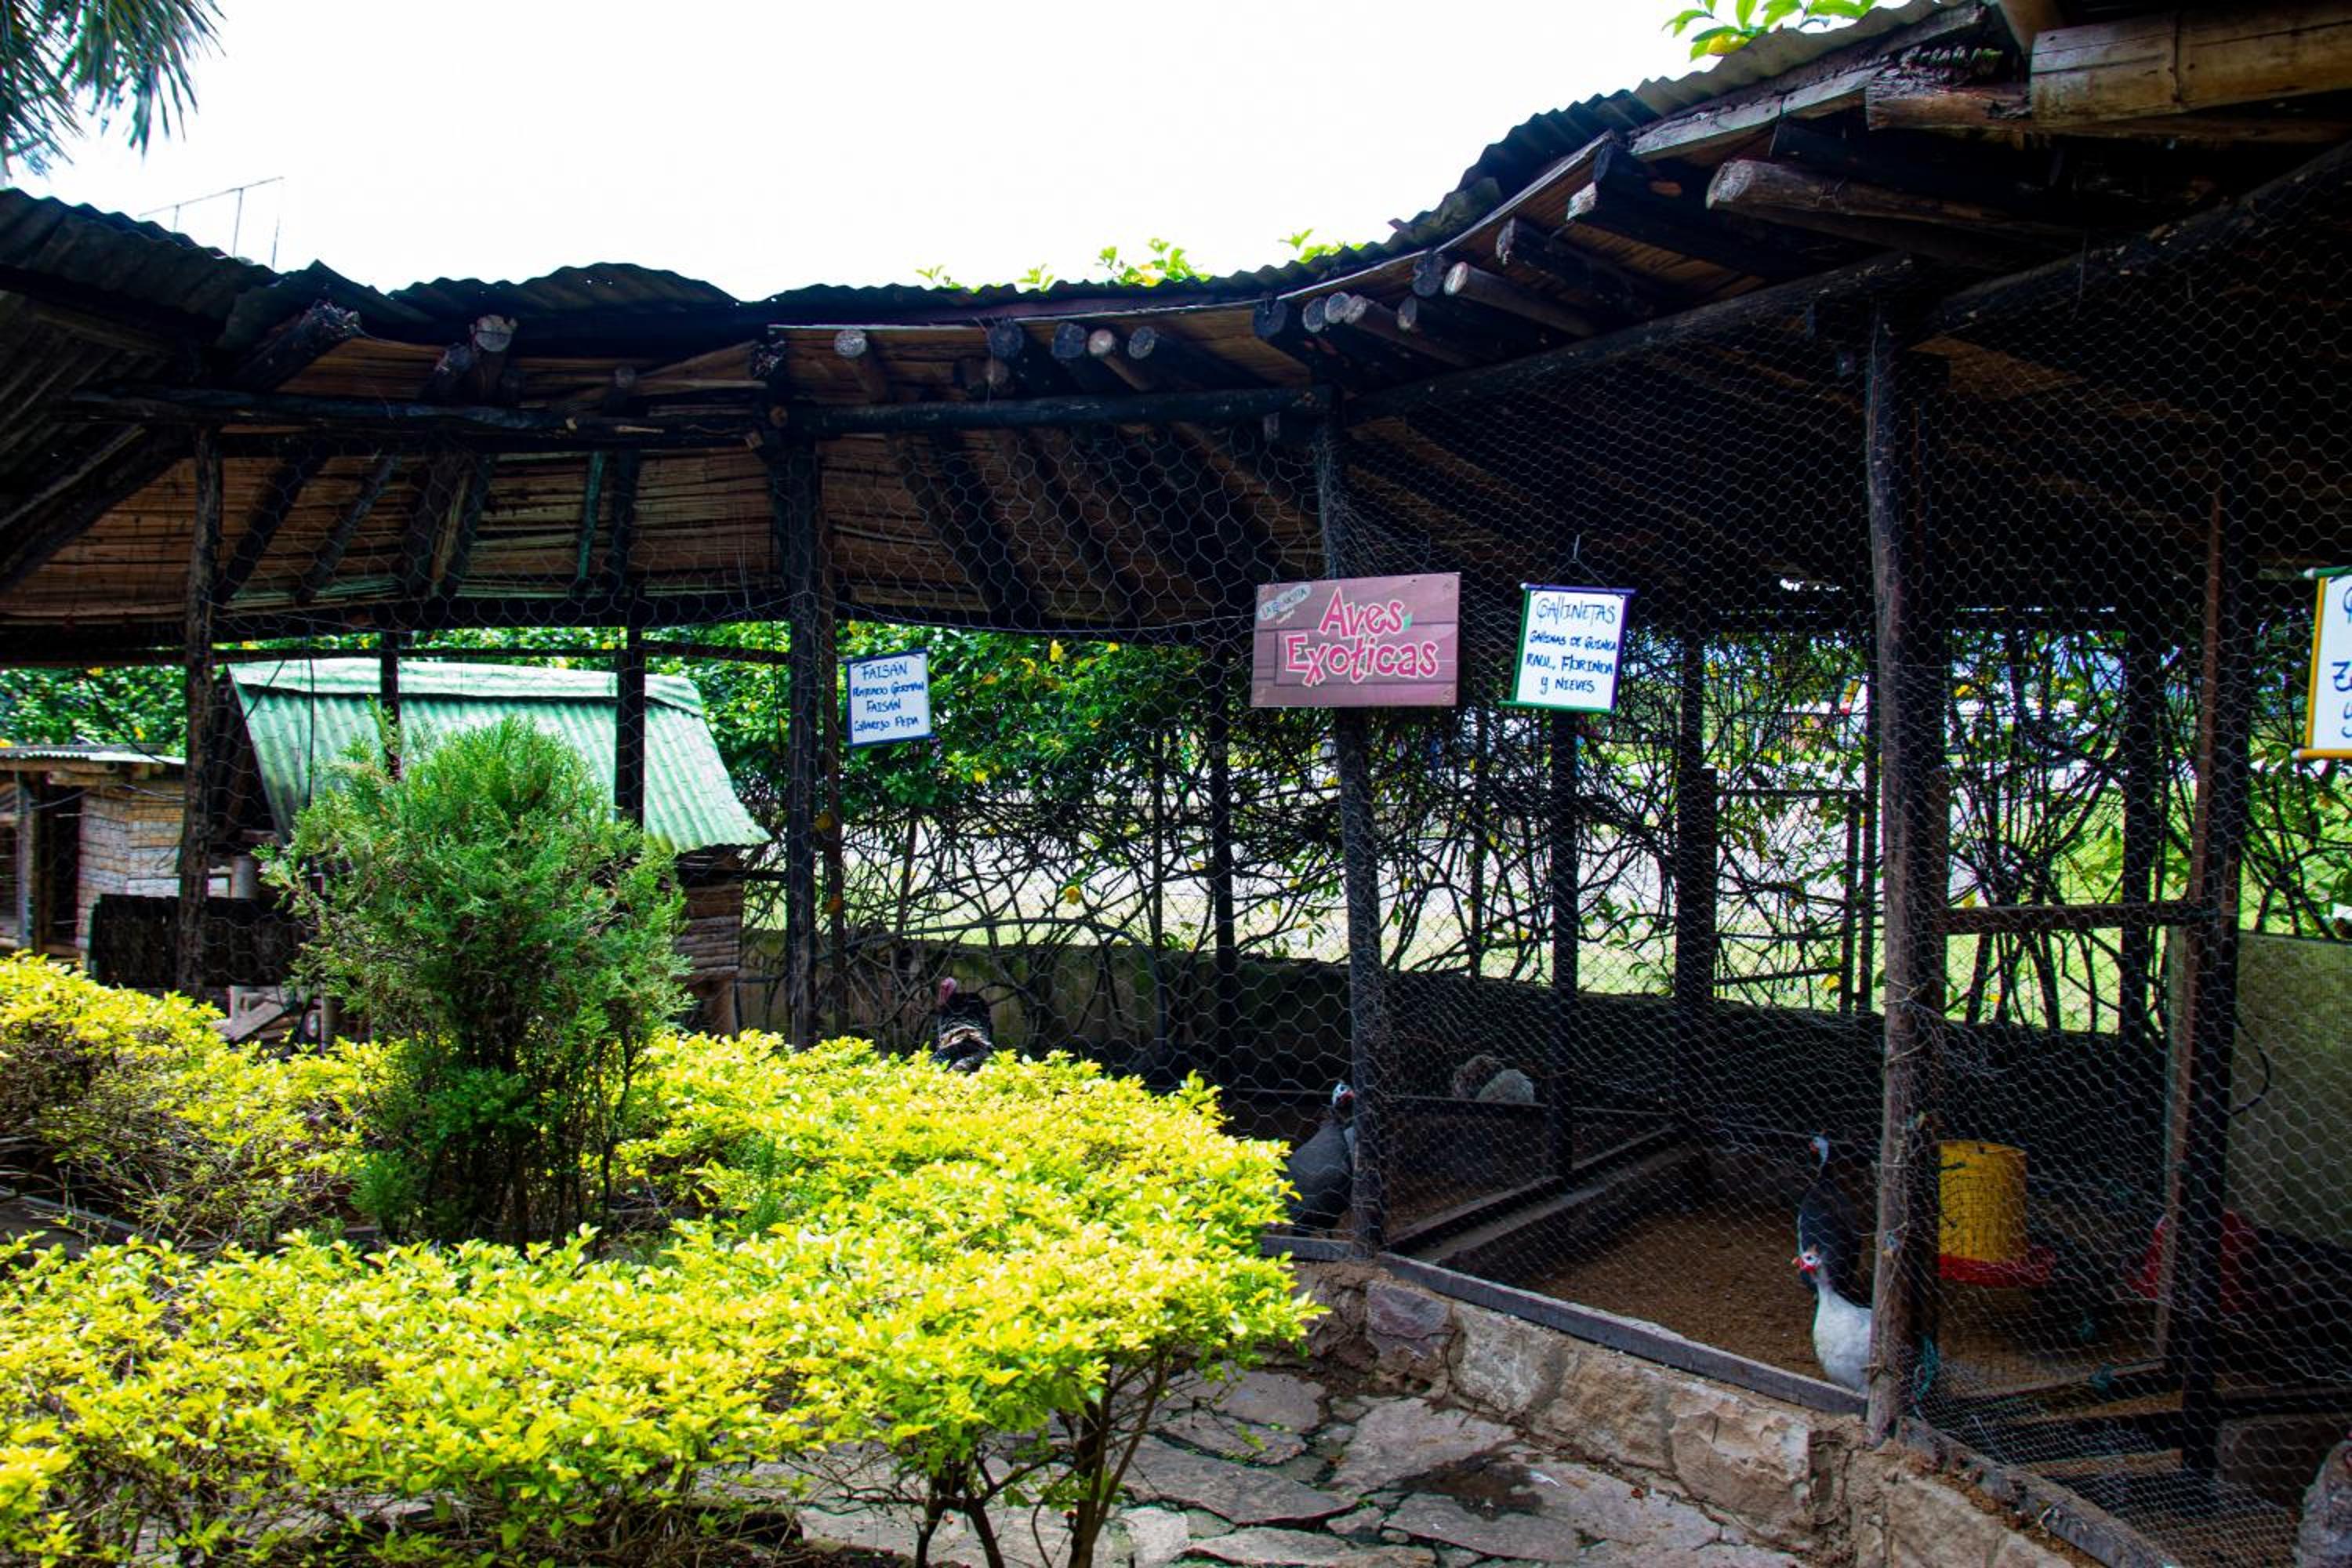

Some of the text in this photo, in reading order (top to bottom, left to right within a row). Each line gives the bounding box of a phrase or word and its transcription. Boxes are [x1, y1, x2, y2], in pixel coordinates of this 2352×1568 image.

[1319, 586, 1404, 639] Aves
[1285, 634, 1439, 687] Exoticas
[1555, 677, 1595, 693] NIEVES
